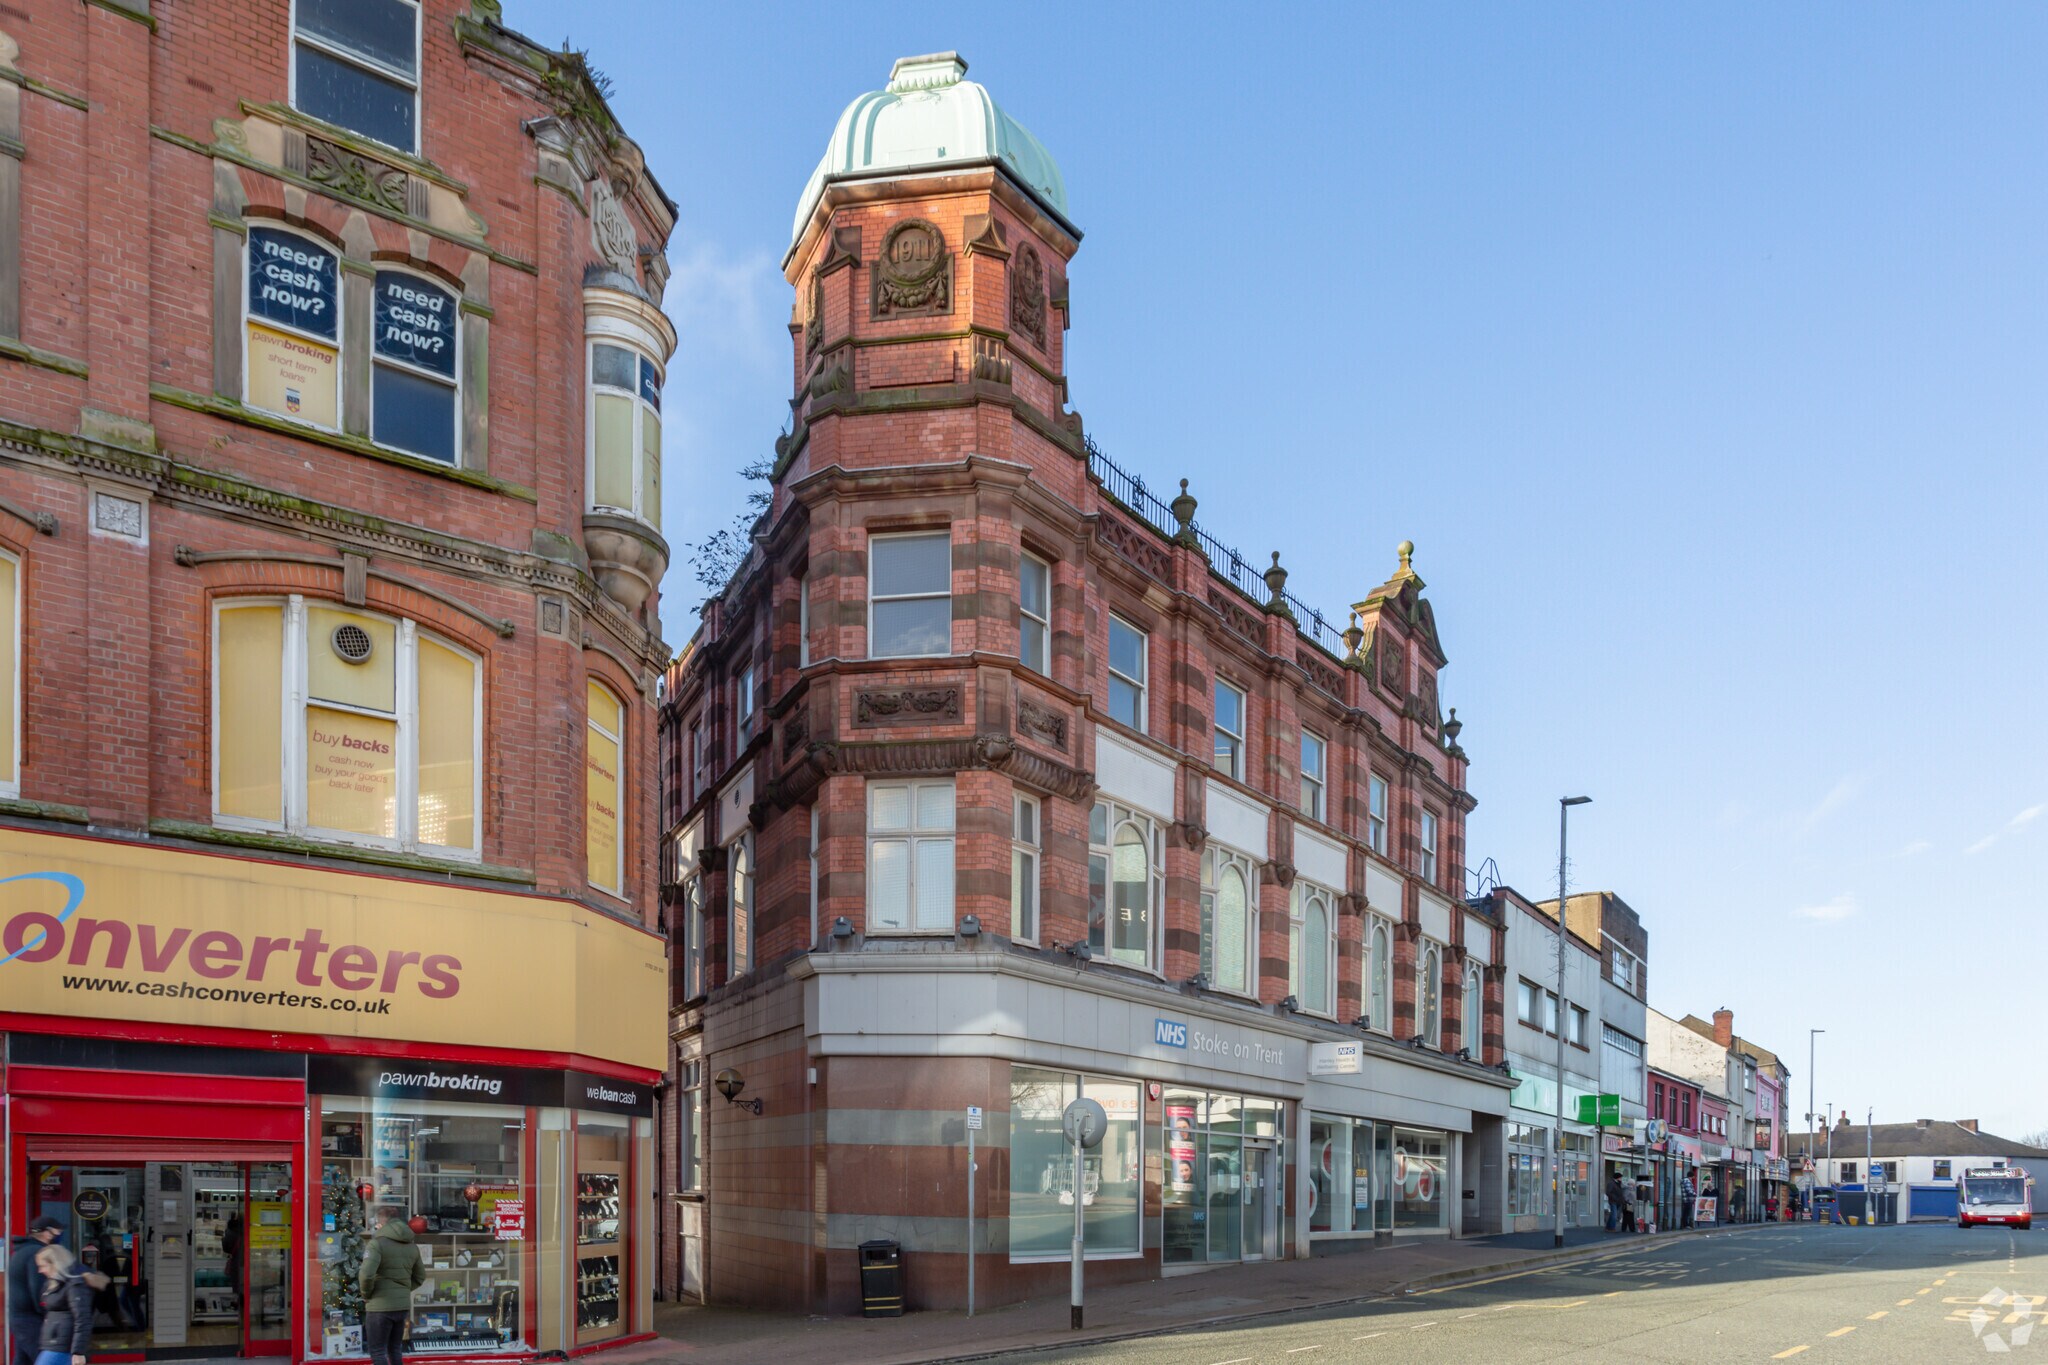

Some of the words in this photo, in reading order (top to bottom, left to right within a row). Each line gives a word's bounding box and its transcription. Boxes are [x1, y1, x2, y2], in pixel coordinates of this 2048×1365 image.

[263, 240, 325, 272] need
[893, 239, 931, 264] 1911
[265, 264, 321, 293] cash
[262, 284, 325, 316] now?
[387, 282, 444, 313] need
[389, 305, 440, 332] cash
[251, 330, 333, 364] pawnbroking
[386, 325, 444, 354] now?
[268, 352, 293, 368] short
[294, 361, 317, 375] term
[279, 369, 306, 384] loans
[312, 730, 340, 748] buy
[341, 734, 390, 754] backs
[314, 764, 333, 776] buy
[334, 769, 355, 778] your
[358, 773, 388, 784] goods
[328, 755, 352, 766] cash
[354, 759, 375, 769] now
[328, 778, 352, 790] back
[354, 783, 375, 793] later
[596, 801, 615, 819] backs
[2, 911, 463, 999] onverters
[62, 975, 391, 1015] www.cashconverters.co.uk
[1156, 1022, 1186, 1047] NHS
[1192, 1031, 1229, 1056] Stoke
[1233, 1044, 1249, 1059] on
[1254, 1043, 1283, 1065] Trent
[1338, 1047, 1355, 1055] NHS
[378, 1071, 502, 1095] pawnbroking
[586, 1086, 599, 1100] we
[600, 1086, 618, 1102] loan
[619, 1091, 637, 1105] cash
